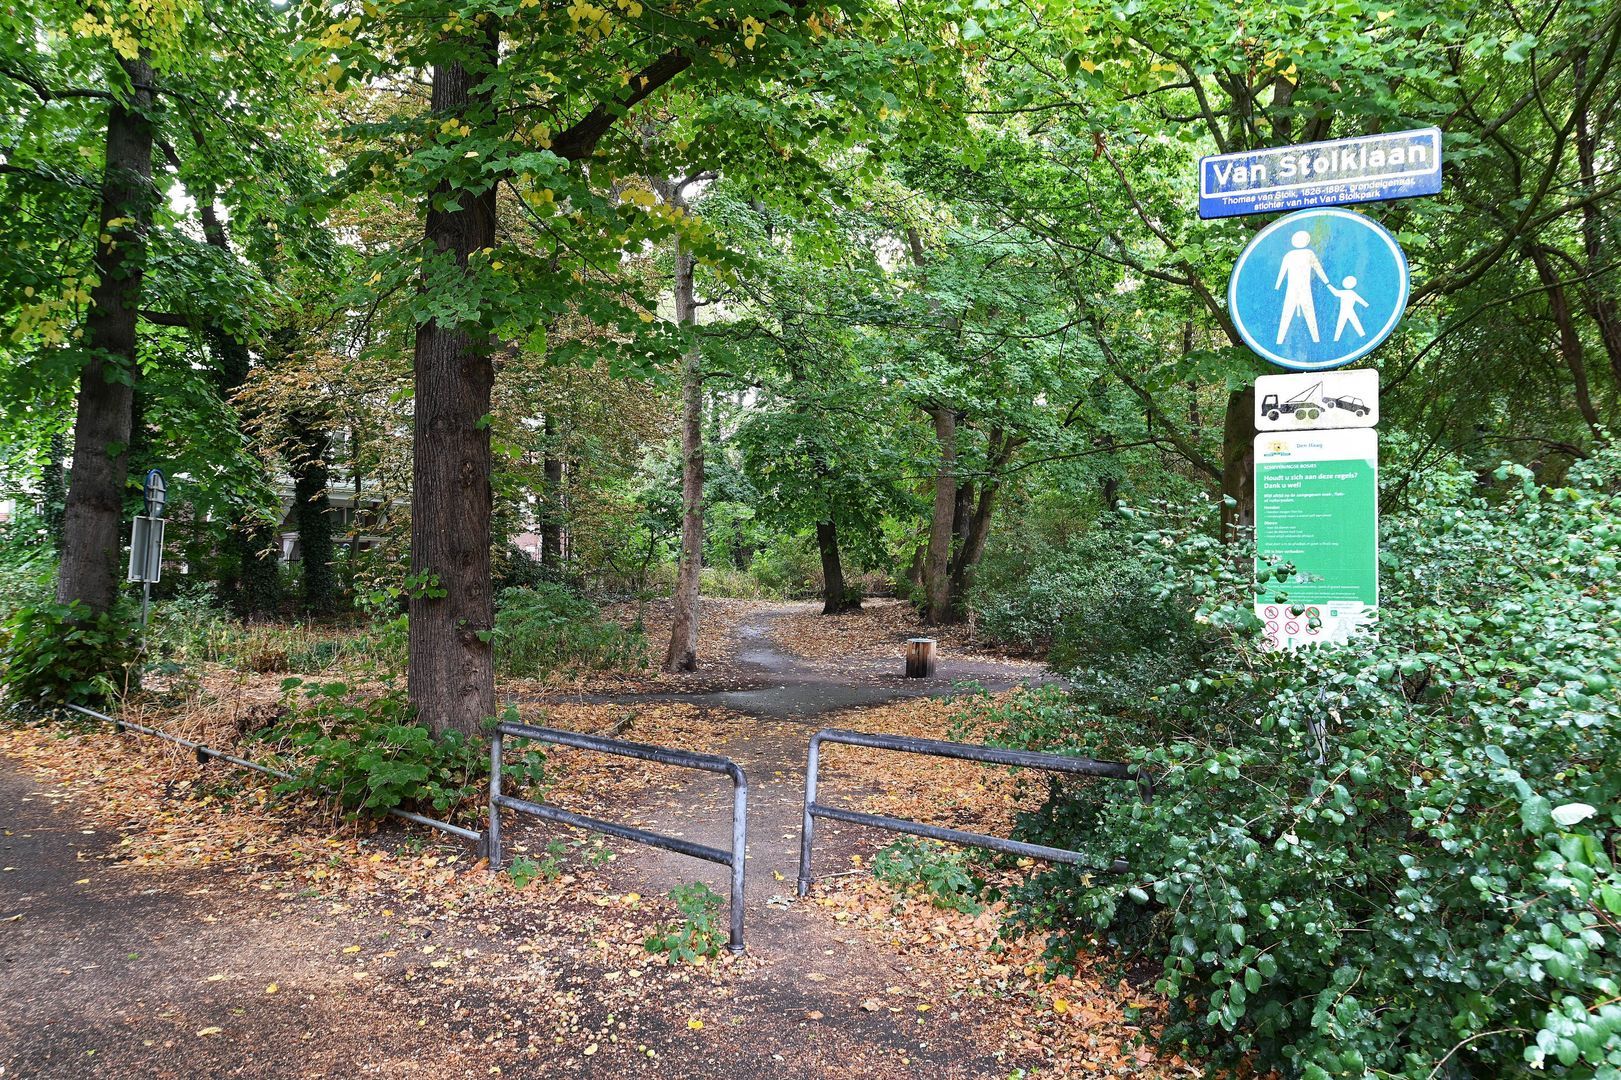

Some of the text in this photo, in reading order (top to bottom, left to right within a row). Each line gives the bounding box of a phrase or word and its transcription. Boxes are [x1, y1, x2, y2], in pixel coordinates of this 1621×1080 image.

[1213, 144, 1426, 186] Van Stolklaan
[1222, 196, 1256, 205] Thomas
[1258, 192, 1276, 201] van
[1254, 190, 1381, 211] stichter van het Van Stolkpark
[1334, 472, 1358, 481] regels?
